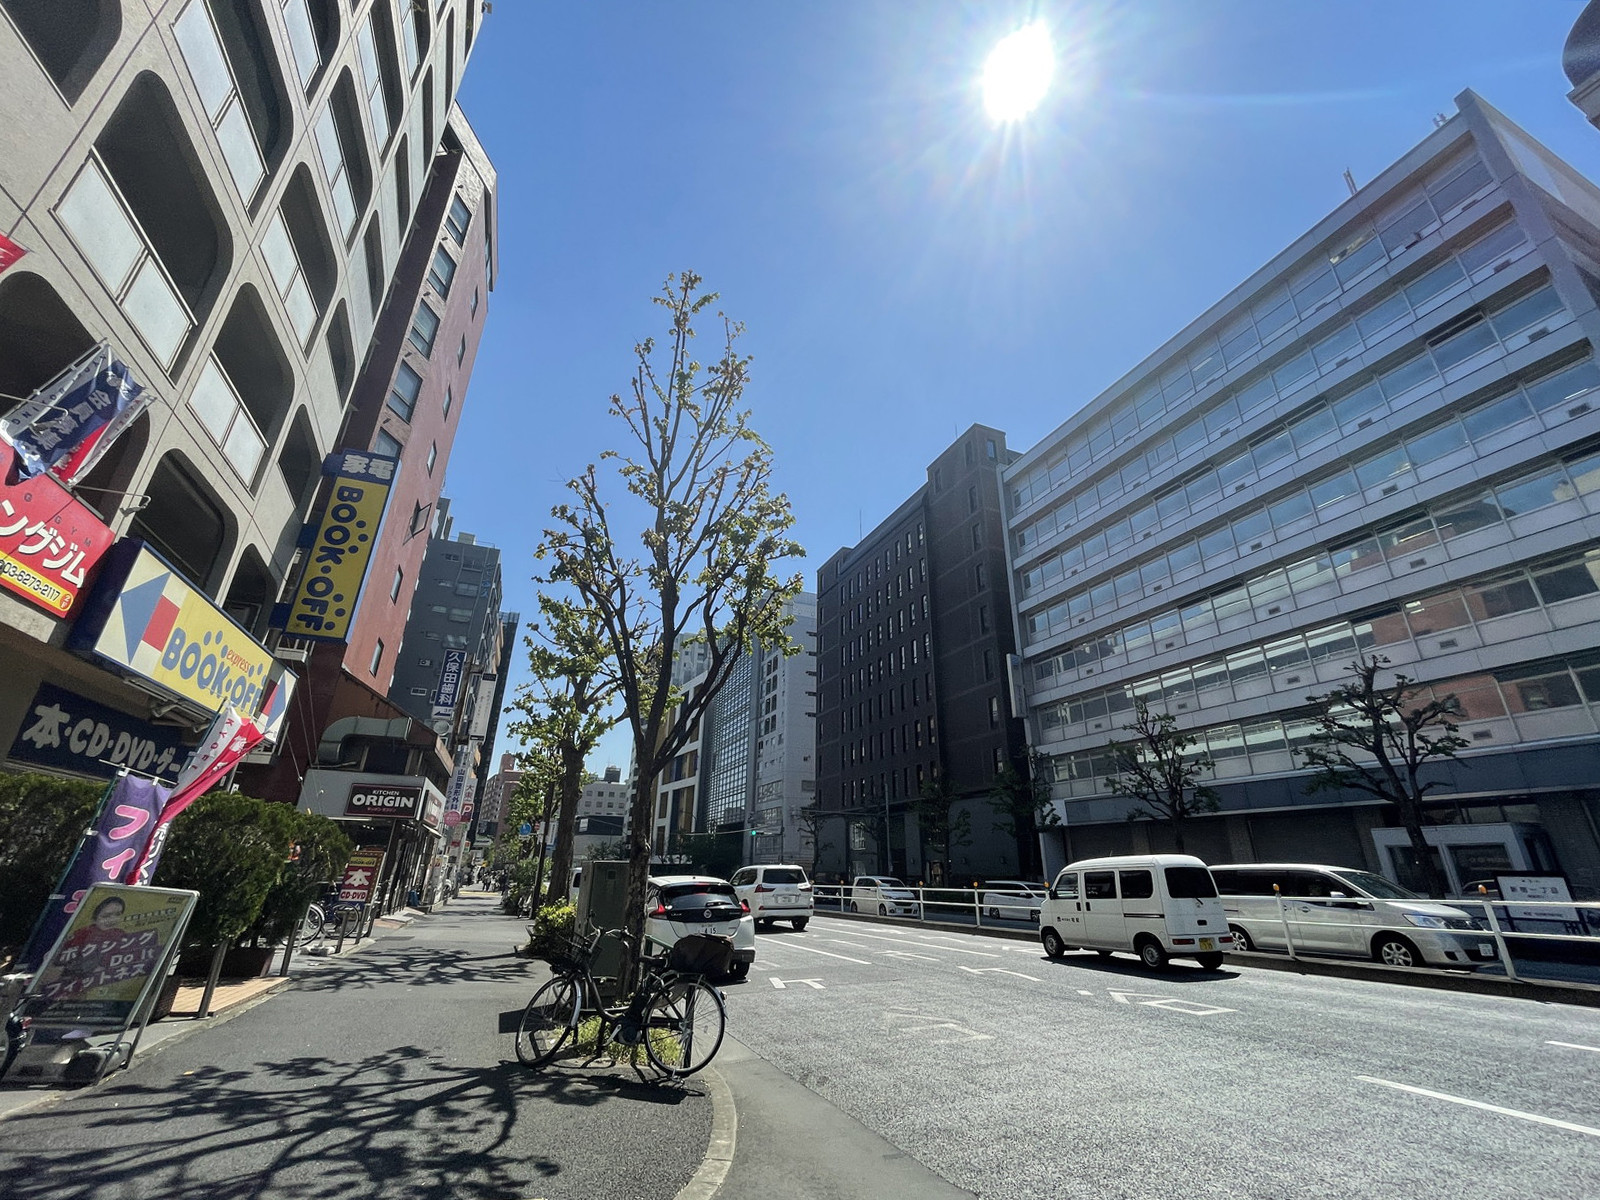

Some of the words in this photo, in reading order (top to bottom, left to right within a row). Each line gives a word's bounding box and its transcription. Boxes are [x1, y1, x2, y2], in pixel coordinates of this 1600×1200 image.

[341, 454, 394, 480] 家電
[3, 561, 61, 602] 03-6273-2117
[226, 649, 251, 673] express
[438, 652, 460, 705] 久保田歯科
[352, 793, 414, 809] ORIGIN
[344, 868, 372, 888] 本
[60, 930, 155, 961] ボクシング
[110, 954, 134, 967] Do
[46, 963, 147, 997] フィットネス
